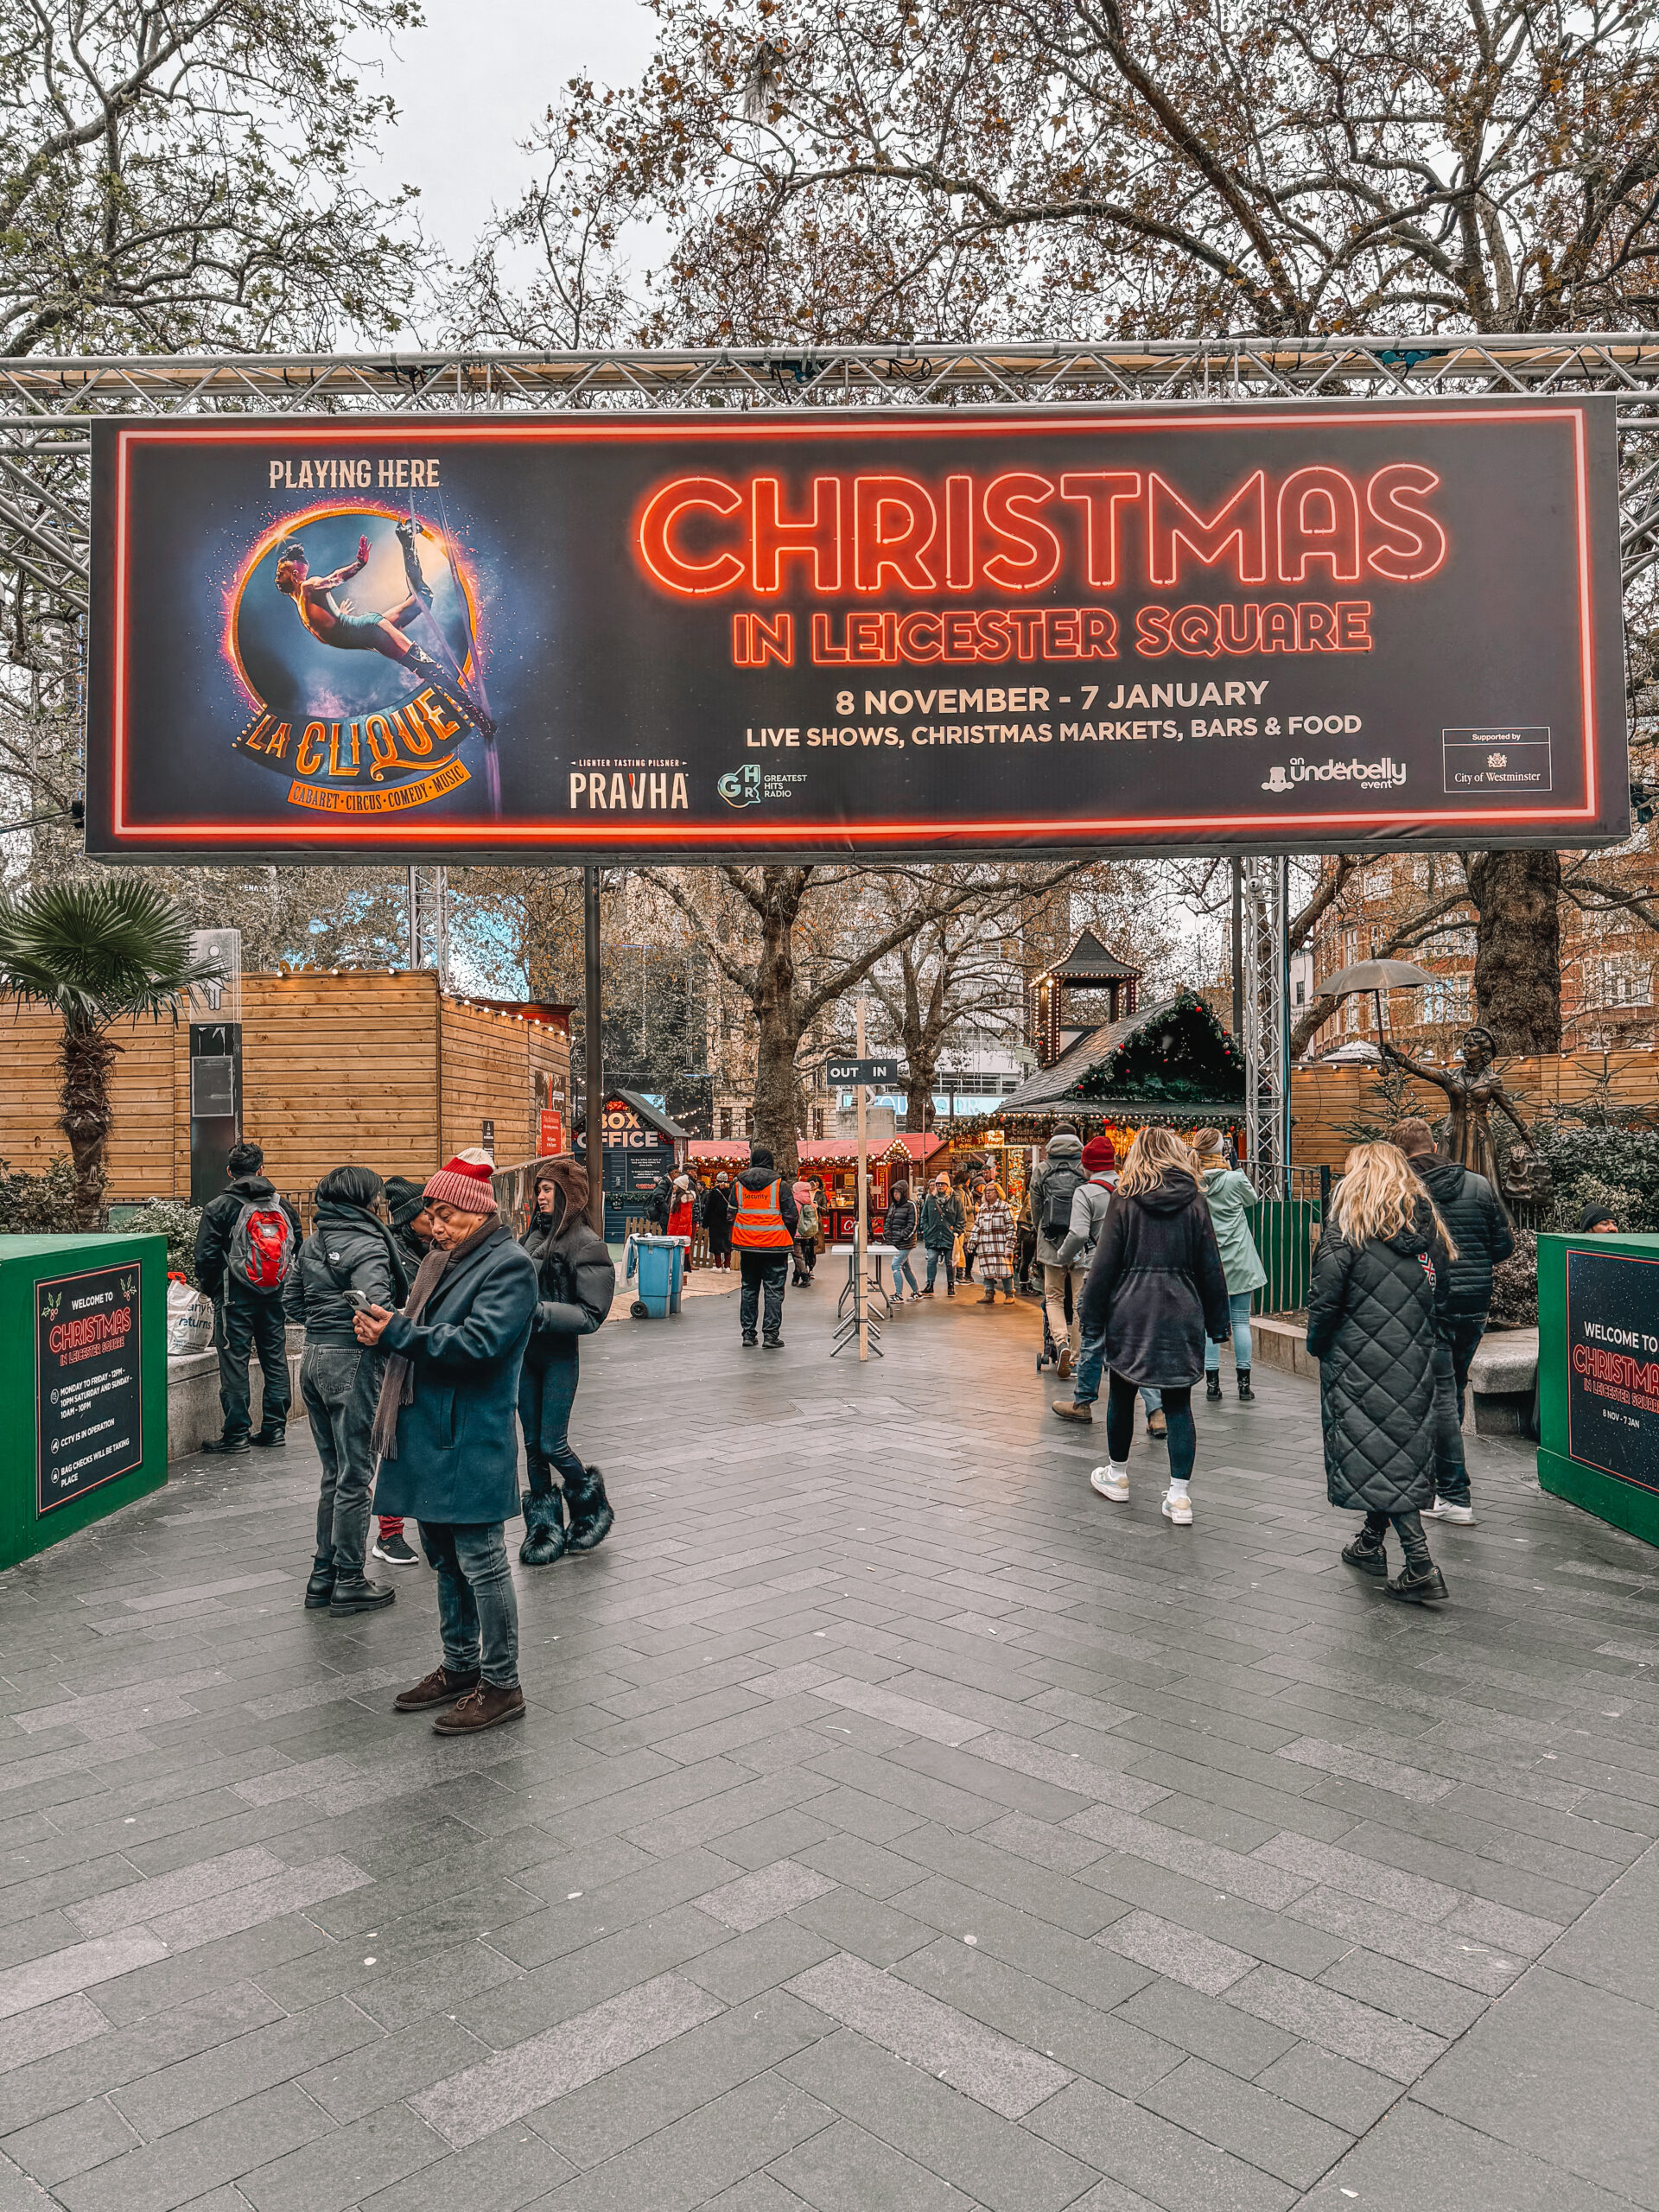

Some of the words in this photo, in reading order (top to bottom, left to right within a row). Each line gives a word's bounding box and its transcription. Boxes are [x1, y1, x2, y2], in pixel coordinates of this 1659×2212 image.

[269, 459, 372, 489] PLAYING
[378, 459, 441, 487] HERE
[639, 463, 1446, 593] CHRISTMAS
[733, 613, 792, 664] IN
[812, 607, 1118, 664] LEICESTER
[1135, 601, 1372, 658] SQUARE
[836, 690, 855, 715] 8
[864, 687, 1050, 715] NOVEMBER
[1080, 685, 1099, 711] 7
[1107, 680, 1270, 710] JANUARY
[245, 713, 293, 759] LA
[296, 686, 461, 782] CLIQUE
[747, 728, 800, 747] LIVE
[806, 726, 906, 749] SHOWS,
[911, 722, 1053, 746] CHRISTMAS
[1059, 719, 1184, 742] MARKETS,
[1191, 716, 1258, 738] BARS
[1264, 716, 1281, 736] &
[1288, 715, 1363, 735] FOOD
[1472, 733, 1510, 742] Supported
[1512, 733, 1521, 742] by
[579, 759, 611, 767] LIGHTER
[613, 759, 645, 767] TASTING
[648, 759, 680, 767] PILSNER
[1454, 772, 1472, 784] City
[1474, 772, 1484, 783] of
[1486, 772, 1541, 782] Westminster
[292, 785, 340, 810] CABARET
[346, 793, 382, 810] CIRCUS
[388, 782, 429, 808] COMEDY
[432, 765, 466, 793] MUSIC
[569, 772, 689, 810] PRAVHA
[764, 774, 807, 783] GREATEST
[1361, 779, 1393, 790] event
[764, 790, 791, 798] RADIO
[830, 1066, 859, 1078] OUT
[873, 1066, 887, 1077] IN
[71, 1293, 104, 1311] WELCOME
[105, 1291, 113, 1301] TO
[188, 1303, 206, 1315] any
[49, 1306, 131, 1354] CHRISTMAS
[178, 1316, 213, 1331] returns.
[1584, 1320, 1640, 1349] WELCOME
[1642, 1334, 1658, 1353] TO
[60, 1353, 67, 1367] IN
[69, 1343, 101, 1364] LEICESTER
[102, 1336, 124, 1353] SQUARE
[60, 1382, 83, 1397] MONDAY
[83, 1379, 90, 1389] TO
[92, 1372, 109, 1385] FRIDAY
[111, 1367, 123, 1378] 12PM
[60, 1396, 74, 1408] 10PM
[74, 1387, 100, 1403] SATURDAY
[100, 1382, 111, 1394] AND
[111, 1375, 130, 1389] SUNDAY
[1583, 1378, 1592, 1393] IN
[1592, 1381, 1630, 1405] LEICESTER
[60, 1407, 74, 1420] 10AM
[78, 1401, 92, 1412] 10PM
[1602, 1408, 1607, 1417] 8
[1607, 1410, 1619, 1421] NOV
[1624, 1415, 1627, 1424] 7
[1628, 1417, 1640, 1429] JAN
[60, 1433, 76, 1447] CCTV
[76, 1433, 81, 1441] IS
[81, 1429, 86, 1439] IN
[87, 1417, 115, 1435] OPERATION
[60, 1464, 73, 1476] BAG
[73, 1453, 93, 1469] CHECKS
[93, 1449, 105, 1461] WILL
[105, 1445, 112, 1455] BE
[112, 1438, 130, 1452] TAKING
[60, 1472, 79, 1488] PLACE
